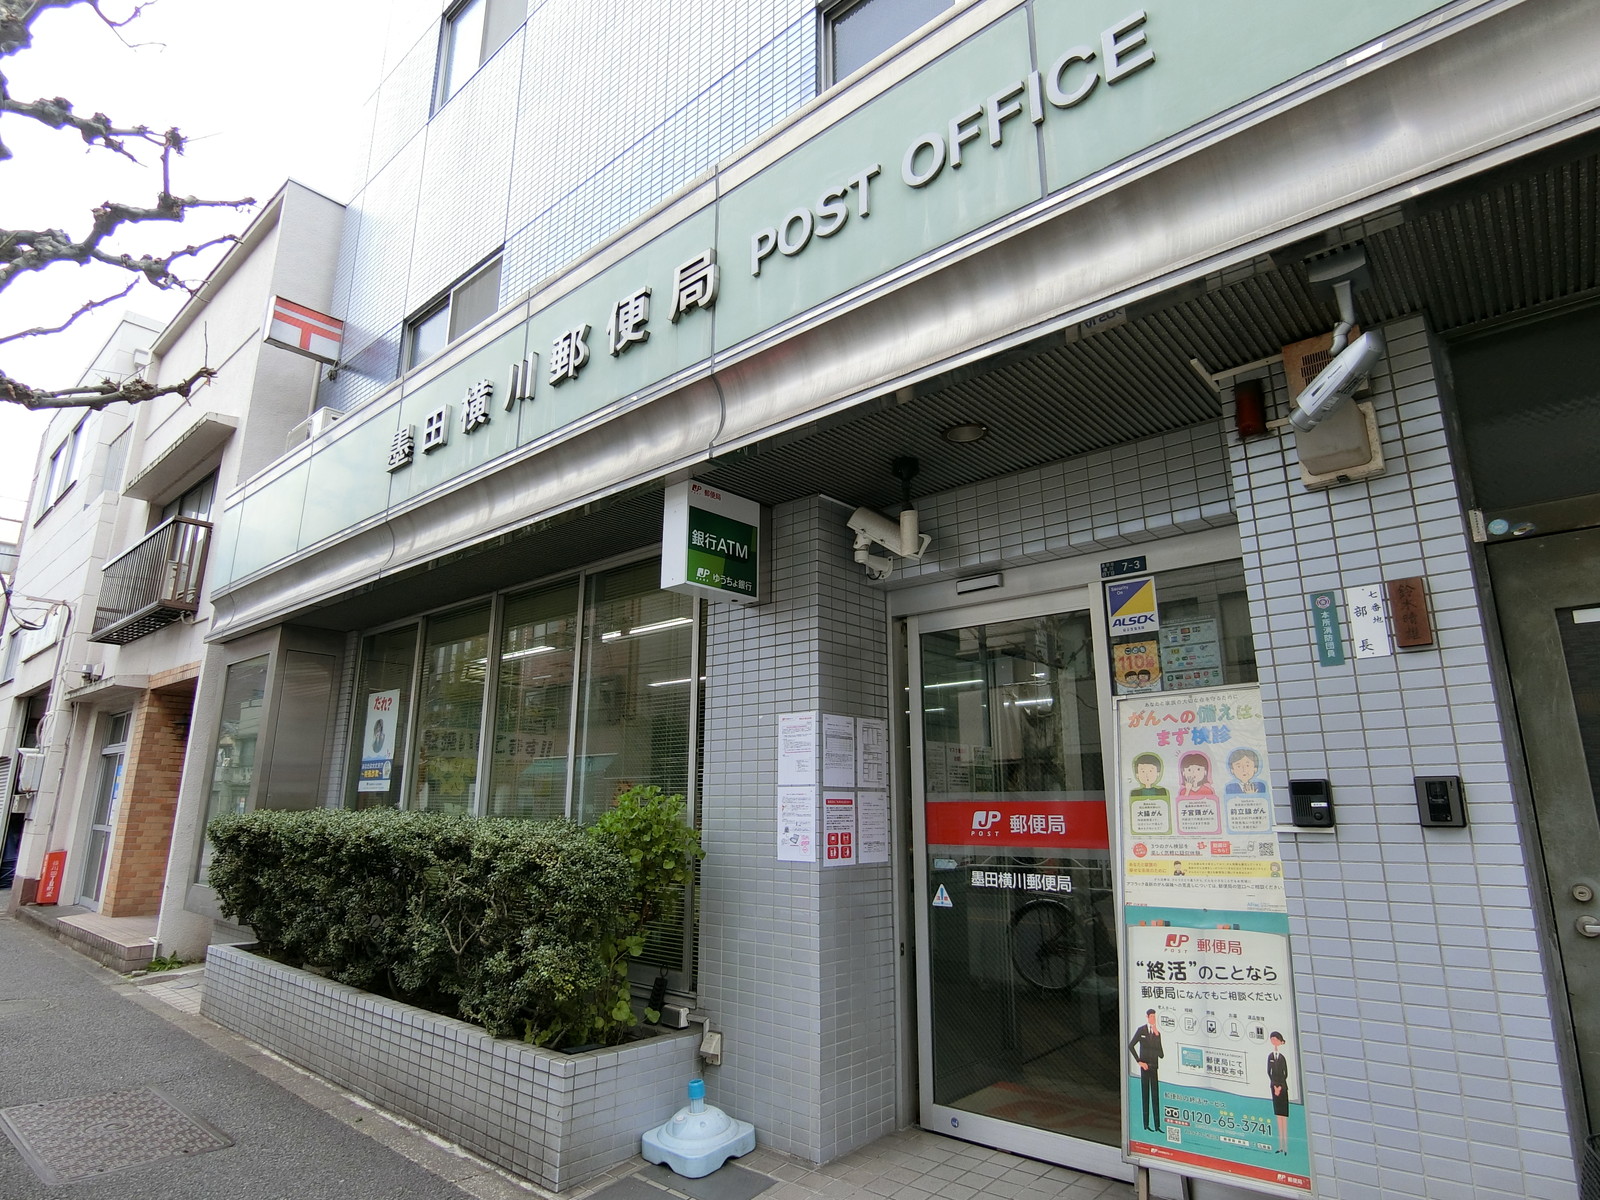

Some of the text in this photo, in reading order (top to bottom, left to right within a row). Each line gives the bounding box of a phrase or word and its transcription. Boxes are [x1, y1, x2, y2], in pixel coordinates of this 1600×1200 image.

[750, 9, 1156, 277] POST OFFICE
[387, 248, 720, 473] 墨田横川郵便局
[692, 529, 748, 559] 銀行ATM
[1121, 560, 1140, 572] 7-3
[713, 573, 752, 591] ゆうちょ銀行
[1368, 590, 1383, 624] 七番地
[1112, 613, 1155, 628] ALSOK
[373, 695, 393, 712] だれ?
[1128, 704, 1262, 728] がんへの備えは、
[1156, 724, 1232, 747] まず検診
[1009, 814, 1066, 835] 郵便局
[971, 870, 1072, 892] 墨田横川郵便局
[1196, 938, 1243, 956] 郵便局
[1141, 986, 1283, 1002] 郵便局になんでもご相談ください
[1206, 1056, 1243, 1068] 郵便局にて
[1206, 1065, 1244, 1077] 無料配布中
[1182, 1108, 1273, 1136] 0120-65-3741
